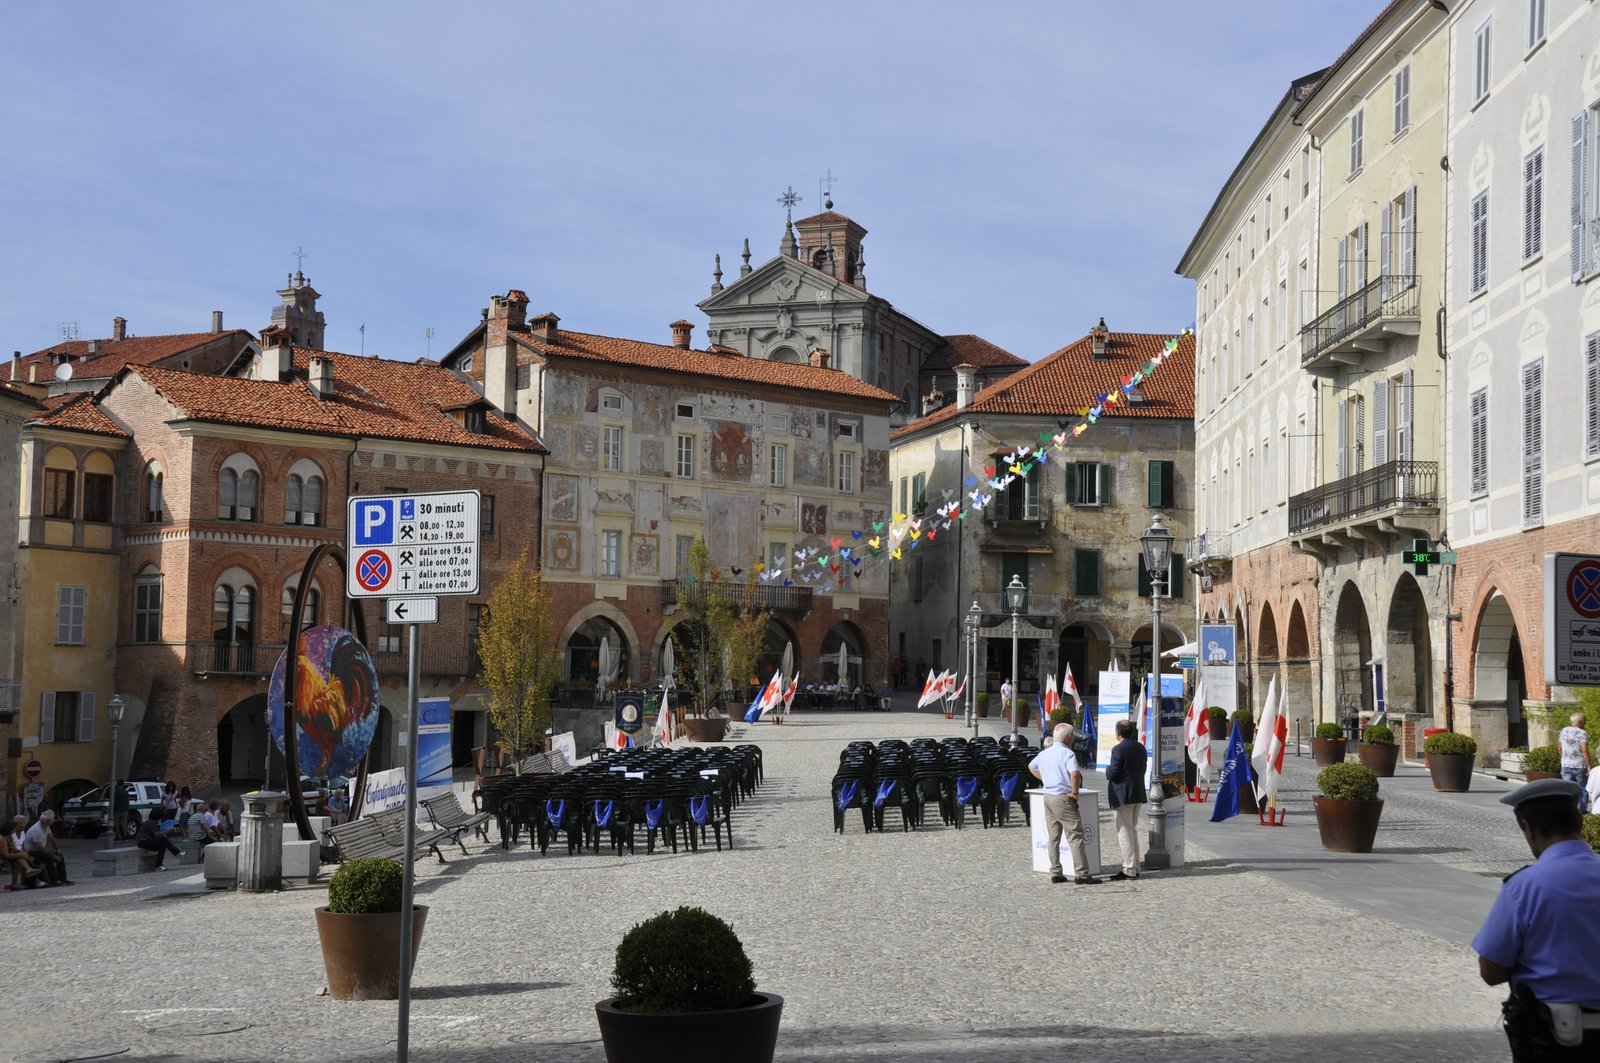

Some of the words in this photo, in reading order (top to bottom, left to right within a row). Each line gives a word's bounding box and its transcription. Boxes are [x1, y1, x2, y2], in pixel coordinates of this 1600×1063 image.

[420, 504, 432, 514] 30
[435, 502, 464, 513] minuti
[364, 504, 386, 538] P
[419, 521, 439, 530] 08.00
[446, 520, 464, 529] 12.30
[419, 533, 438, 541] 14.30
[445, 531, 464, 539] 19.00
[419, 547, 437, 556] dalle
[453, 546, 472, 554] 19.45
[419, 558, 434, 567] alle
[449, 557, 469, 566] 07.00
[418, 570, 437, 579] dalle
[453, 569, 471, 577] 13.00
[418, 581, 434, 590] alle
[448, 580, 468, 588] 07.00
